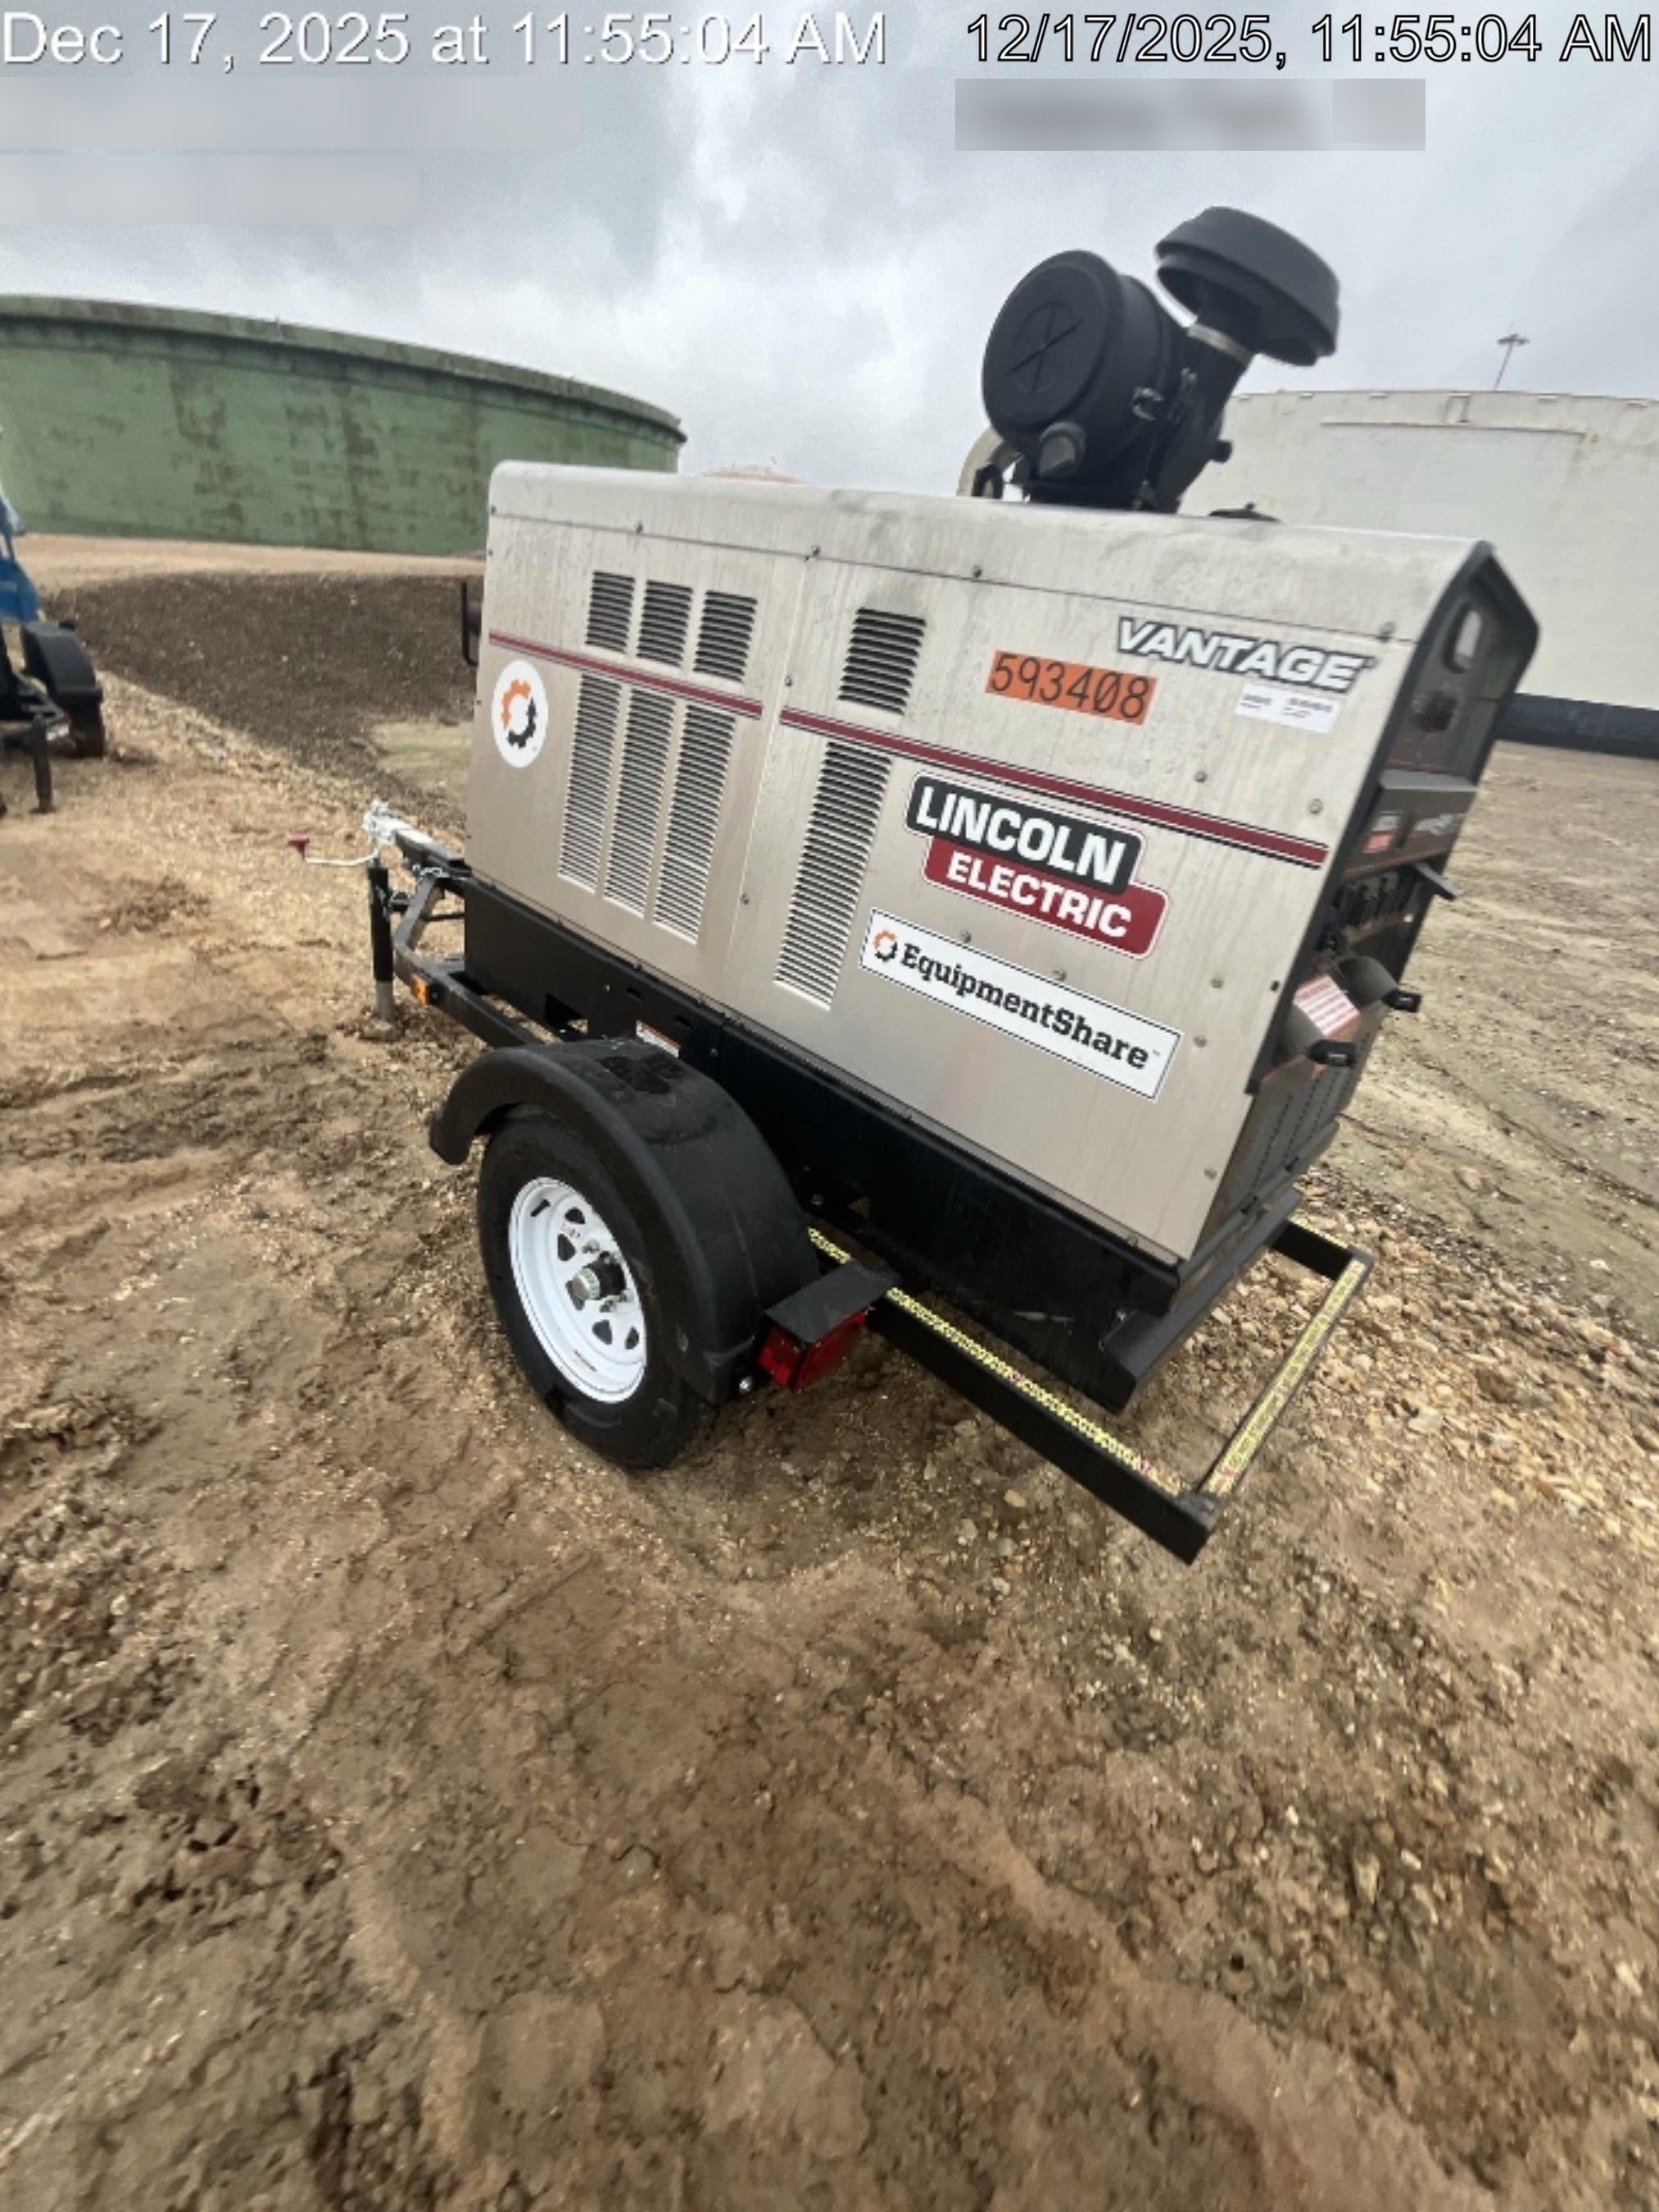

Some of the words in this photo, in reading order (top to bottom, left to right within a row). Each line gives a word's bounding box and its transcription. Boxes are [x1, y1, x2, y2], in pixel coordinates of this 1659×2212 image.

[990, 653, 1150, 720] 593408
[1119, 618, 1364, 693] VANTAGE
[916, 786, 1126, 885] LINCOLN
[946, 850, 1132, 938] ELECTRIC
[900, 943, 1149, 1069] EquipmentShare
